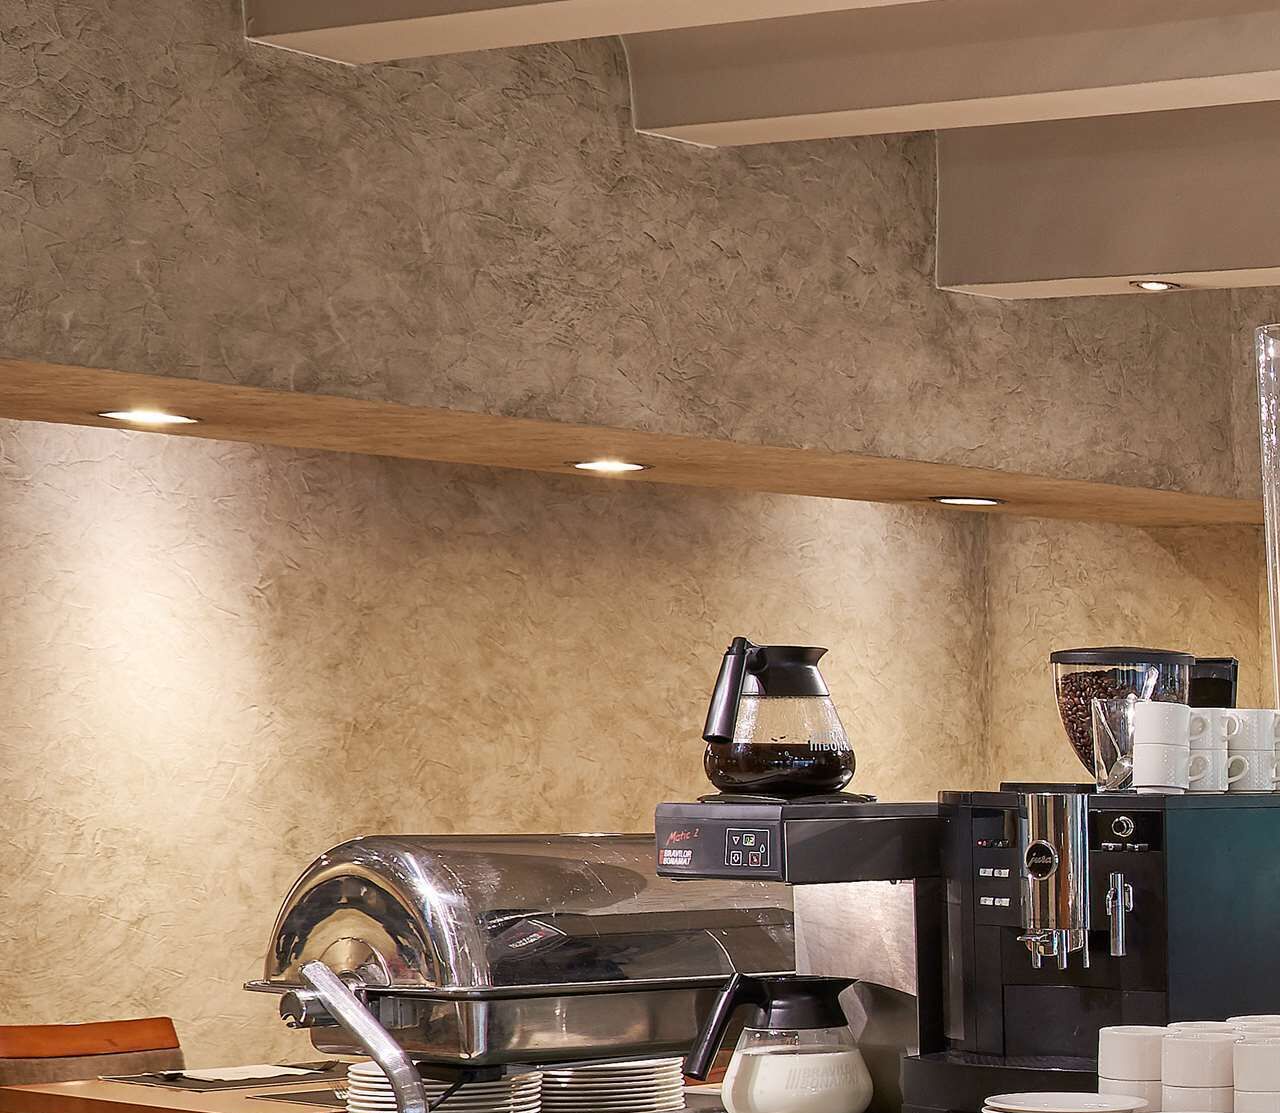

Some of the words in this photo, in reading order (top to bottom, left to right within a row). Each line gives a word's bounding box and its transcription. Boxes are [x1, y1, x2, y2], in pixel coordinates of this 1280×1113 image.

[666, 830, 690, 845] Matic
[664, 849, 692, 857] BRAVILOR
[662, 857, 692, 865] BONAMAT
[1028, 852, 1052, 868] jura
